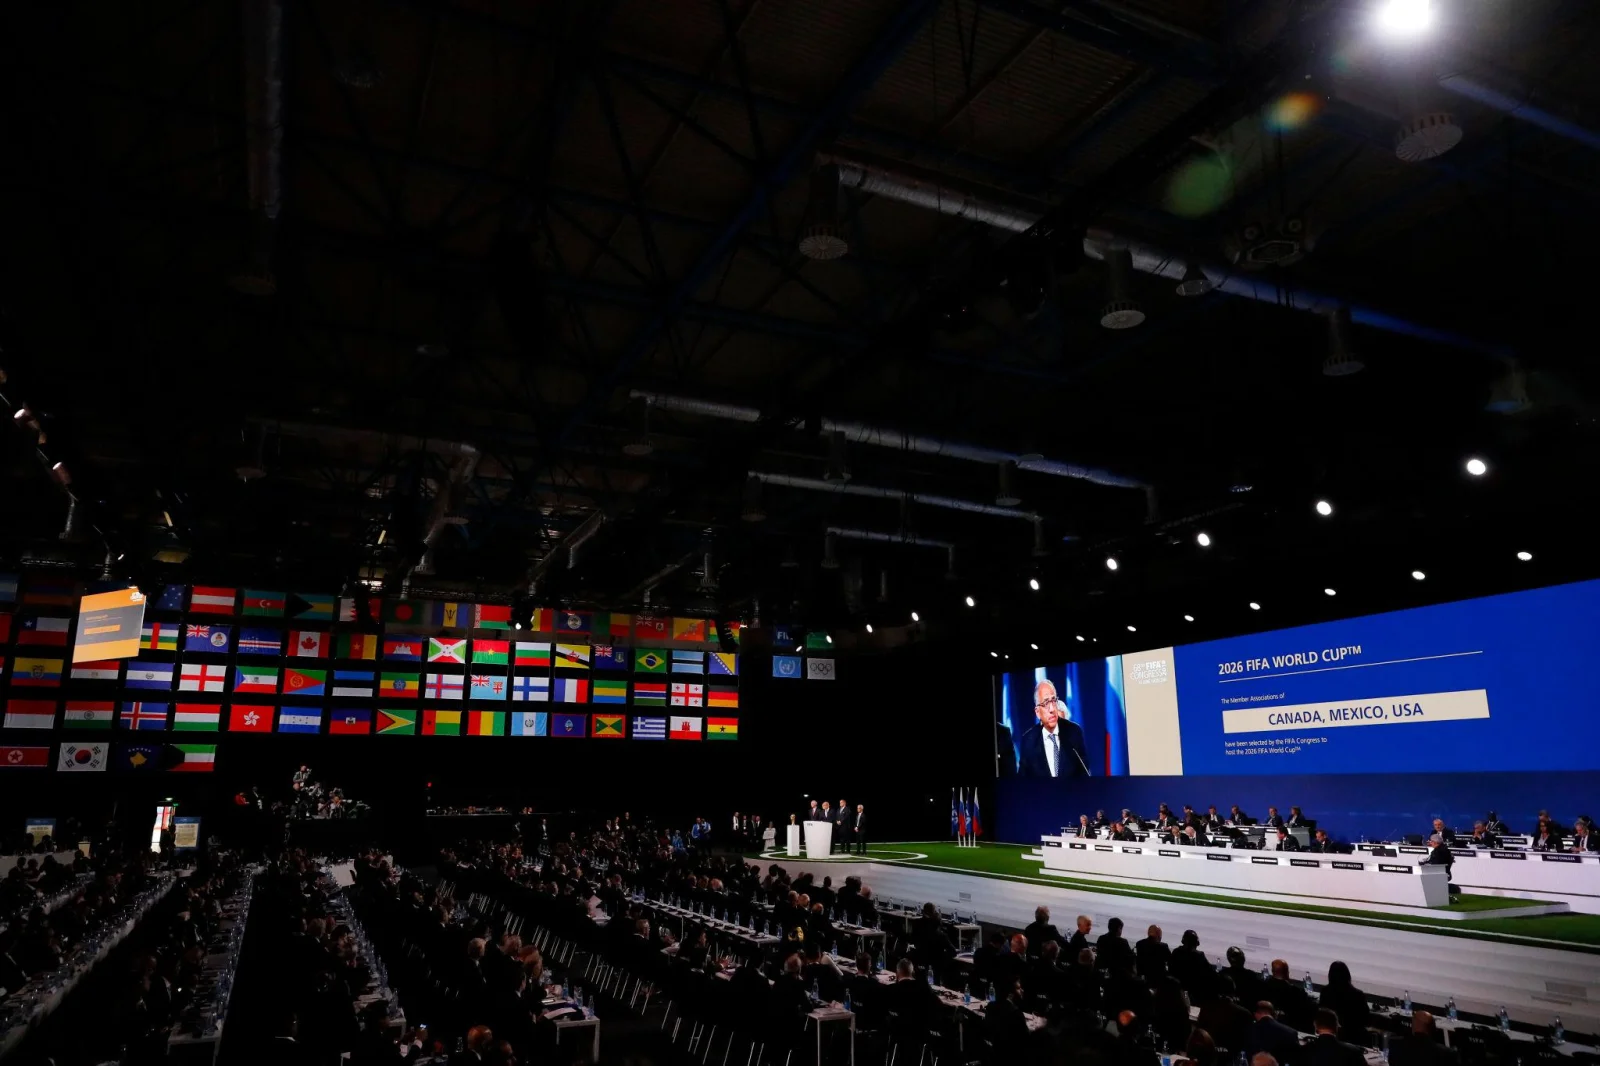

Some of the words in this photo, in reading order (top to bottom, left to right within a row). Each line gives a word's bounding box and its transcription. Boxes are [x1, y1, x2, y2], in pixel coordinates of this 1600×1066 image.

[1145, 660, 1161, 671] FIFA
[1218, 661, 1243, 675] 2026
[1246, 658, 1270, 672] FIFA
[1272, 651, 1318, 668] WORLD
[1230, 696, 1249, 704] Member
[1250, 694, 1278, 702] Associations
[1268, 710, 1326, 725] CANADA,
[1329, 705, 1388, 722] MEXICO,
[1392, 702, 1424, 717] USA
[1249, 739, 1267, 747] selected
[1268, 739, 1275, 747] by
[1296, 737, 1320, 745] Congress
